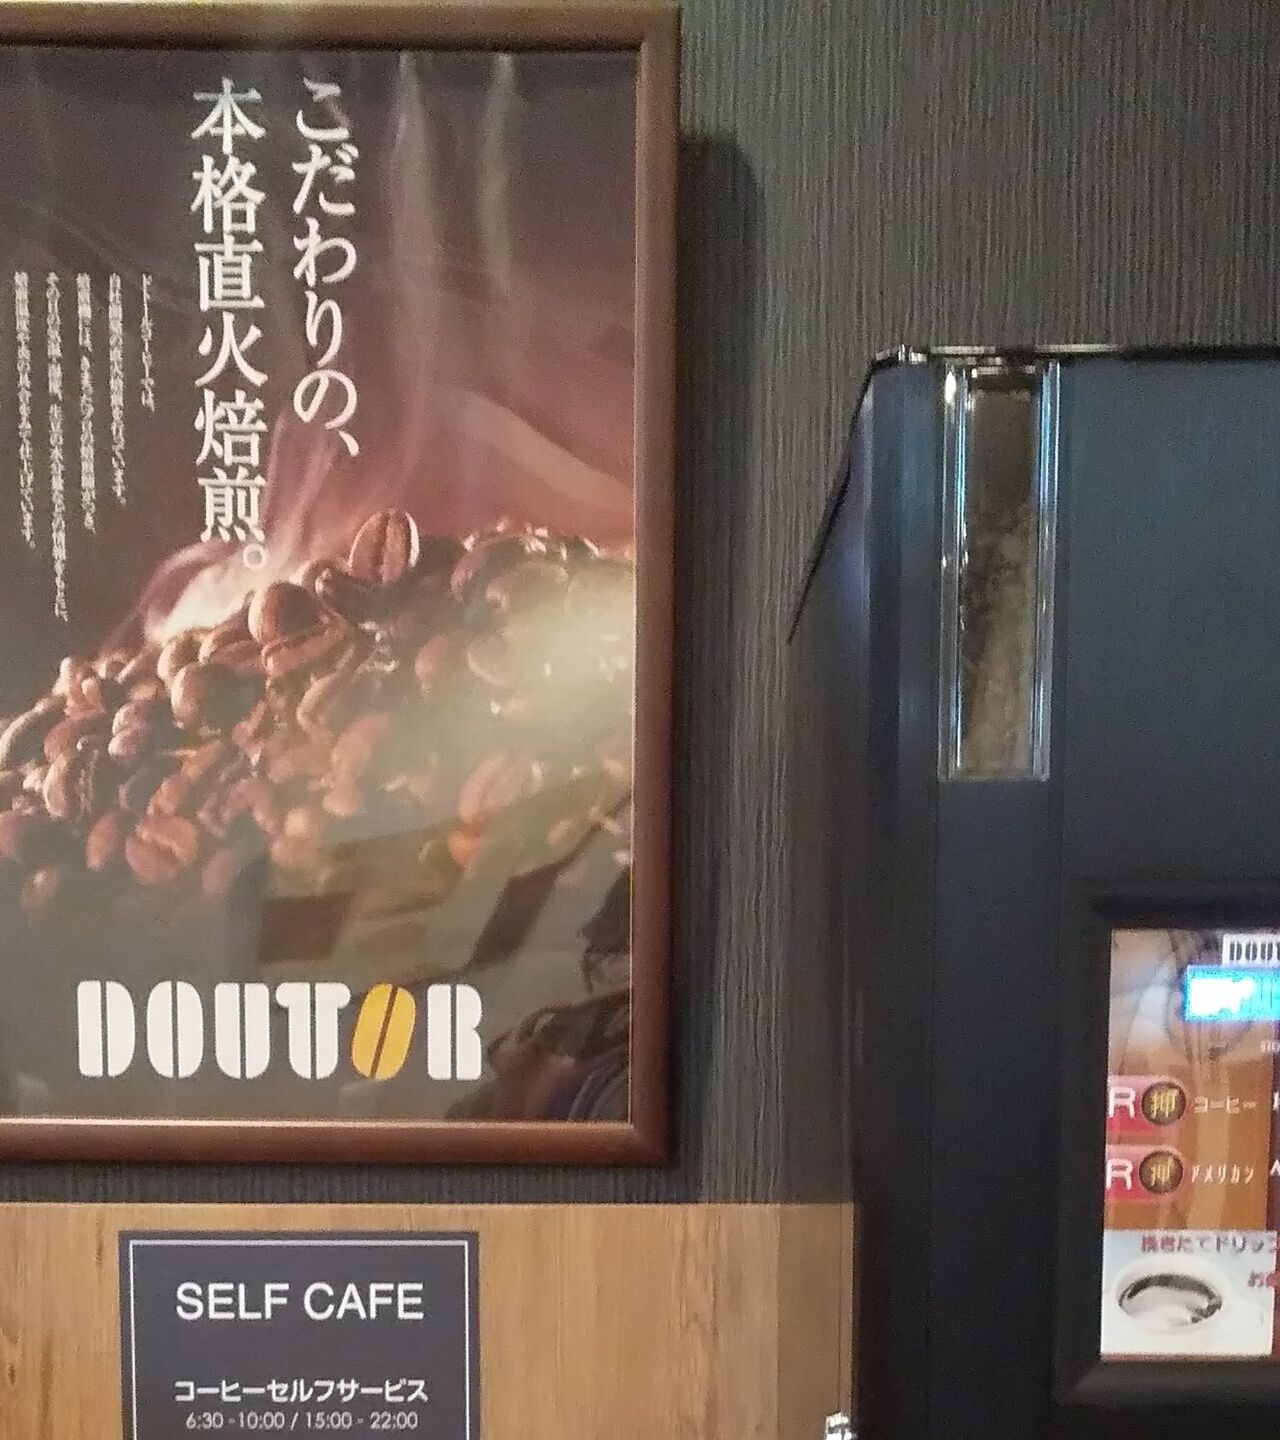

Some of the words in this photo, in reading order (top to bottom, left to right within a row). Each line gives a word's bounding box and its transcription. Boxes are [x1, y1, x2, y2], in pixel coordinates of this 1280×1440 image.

[291, 76, 361, 458] こだわりの、
[190, 76, 270, 573] 本格直火焙煎。
[76, 979, 483, 1082] DOUTOR
[175, 1281, 290, 1321] SELF
[303, 1281, 425, 1321] CAFE
[174, 1377, 429, 1403] コーヒーセルフサービス
[185, 1411, 224, 1430] 6:30
[238, 1411, 286, 1430] 10:00
[306, 1411, 353, 1430] 15:00
[369, 1411, 419, 1430] 22:00
